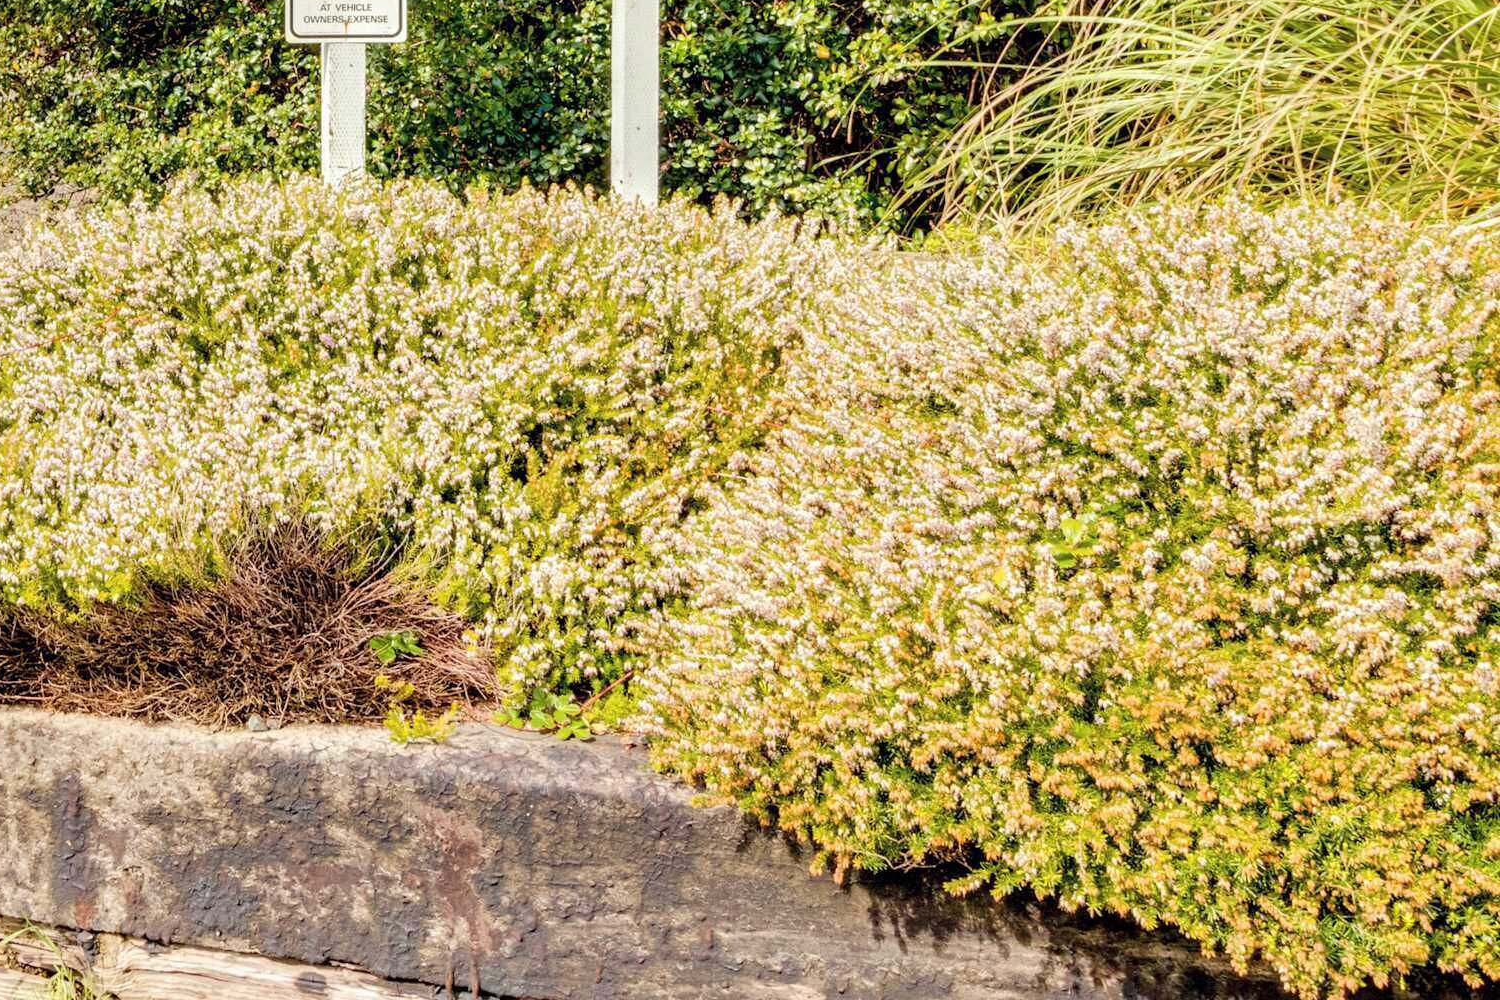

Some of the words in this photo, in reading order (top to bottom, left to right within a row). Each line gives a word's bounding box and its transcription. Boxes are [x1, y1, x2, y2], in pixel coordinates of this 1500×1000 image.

[320, 3, 331, 12] AT
[335, 3, 373, 12] VEHICLE
[347, 15, 388, 24] EXPENSE
